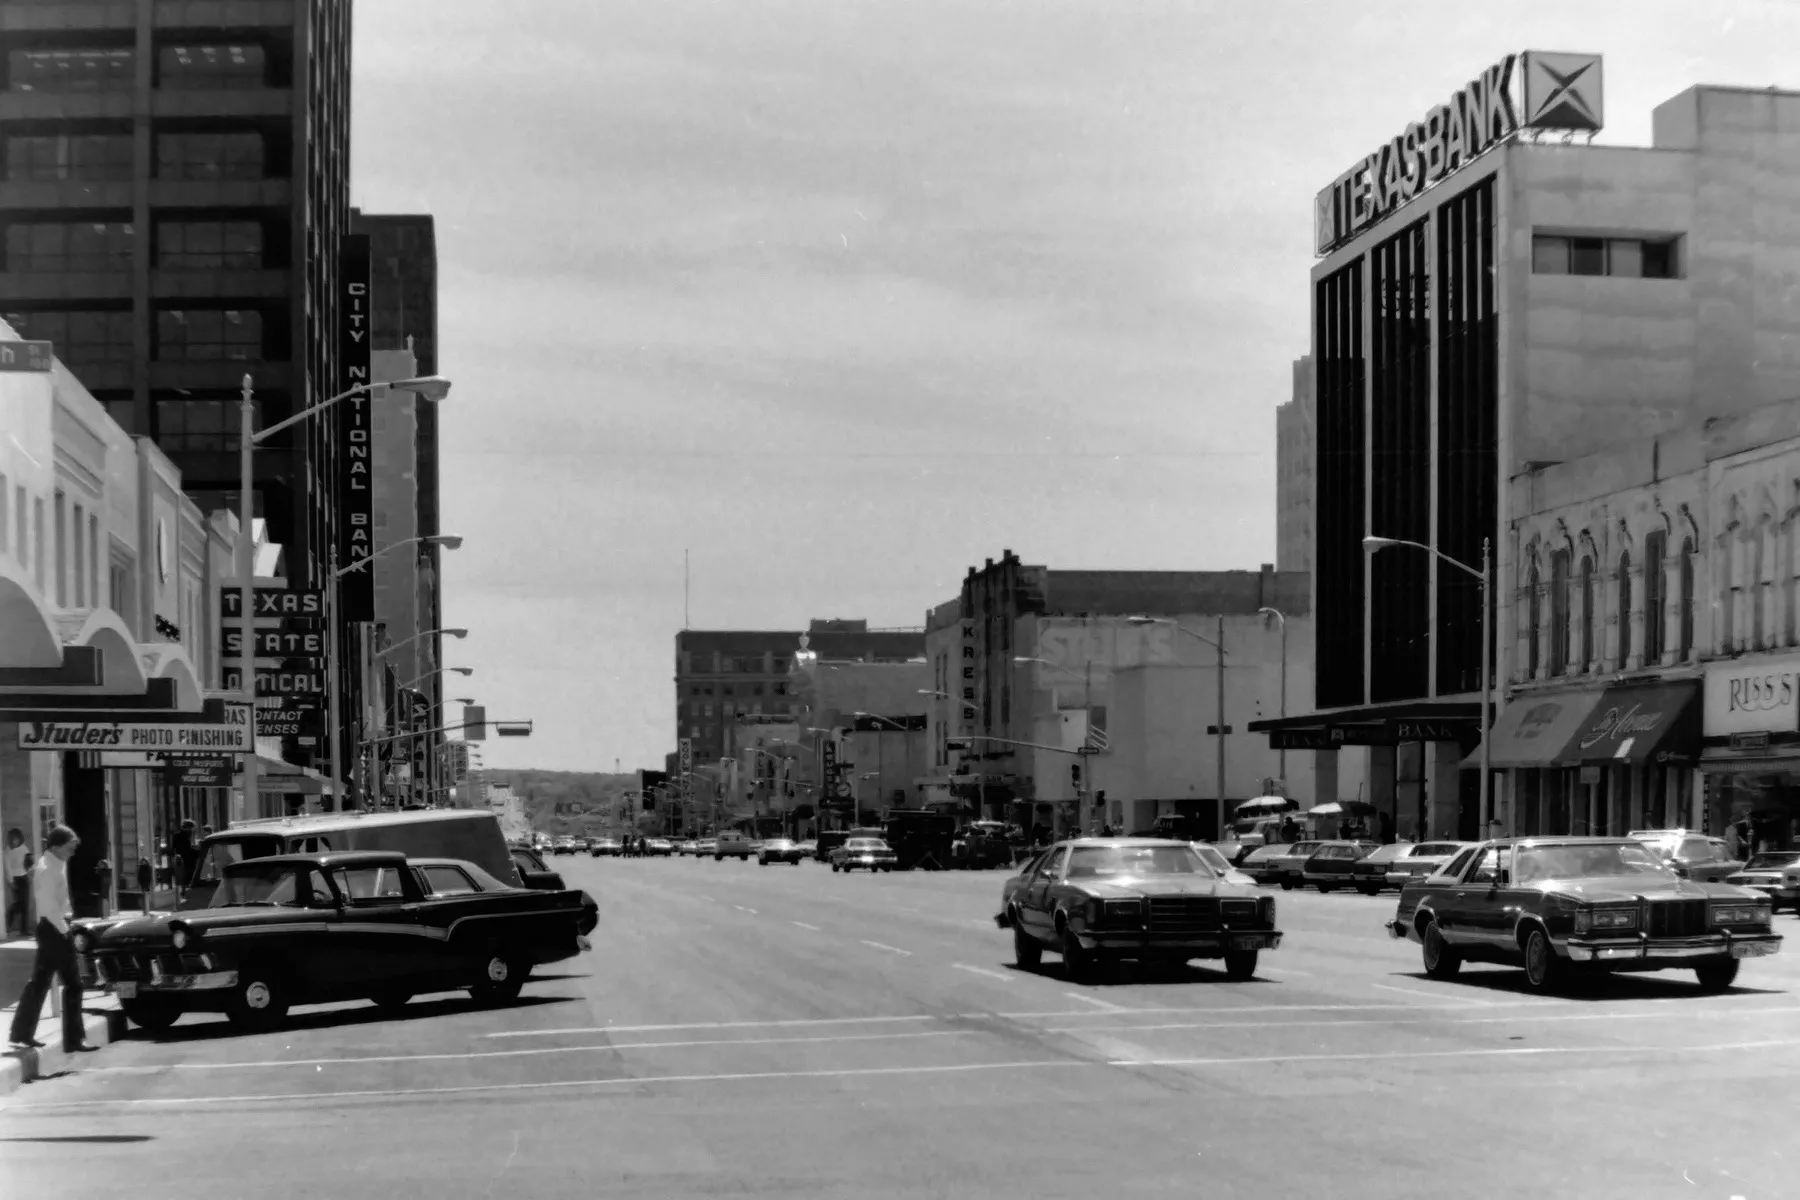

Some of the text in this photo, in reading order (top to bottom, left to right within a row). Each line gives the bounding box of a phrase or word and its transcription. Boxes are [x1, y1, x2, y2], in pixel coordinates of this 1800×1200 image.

[348, 282, 366, 343] CITY
[348, 366, 368, 490] NATIONAL
[224, 593, 318, 612] TXAS
[227, 673, 322, 692] OTICAL
[963, 626, 974, 719] KRESS
[256, 711, 303, 721] ONTACT
[24, 722, 243, 747] Studer's PHOTO FINISHING
[256, 724, 299, 734] ENSES
